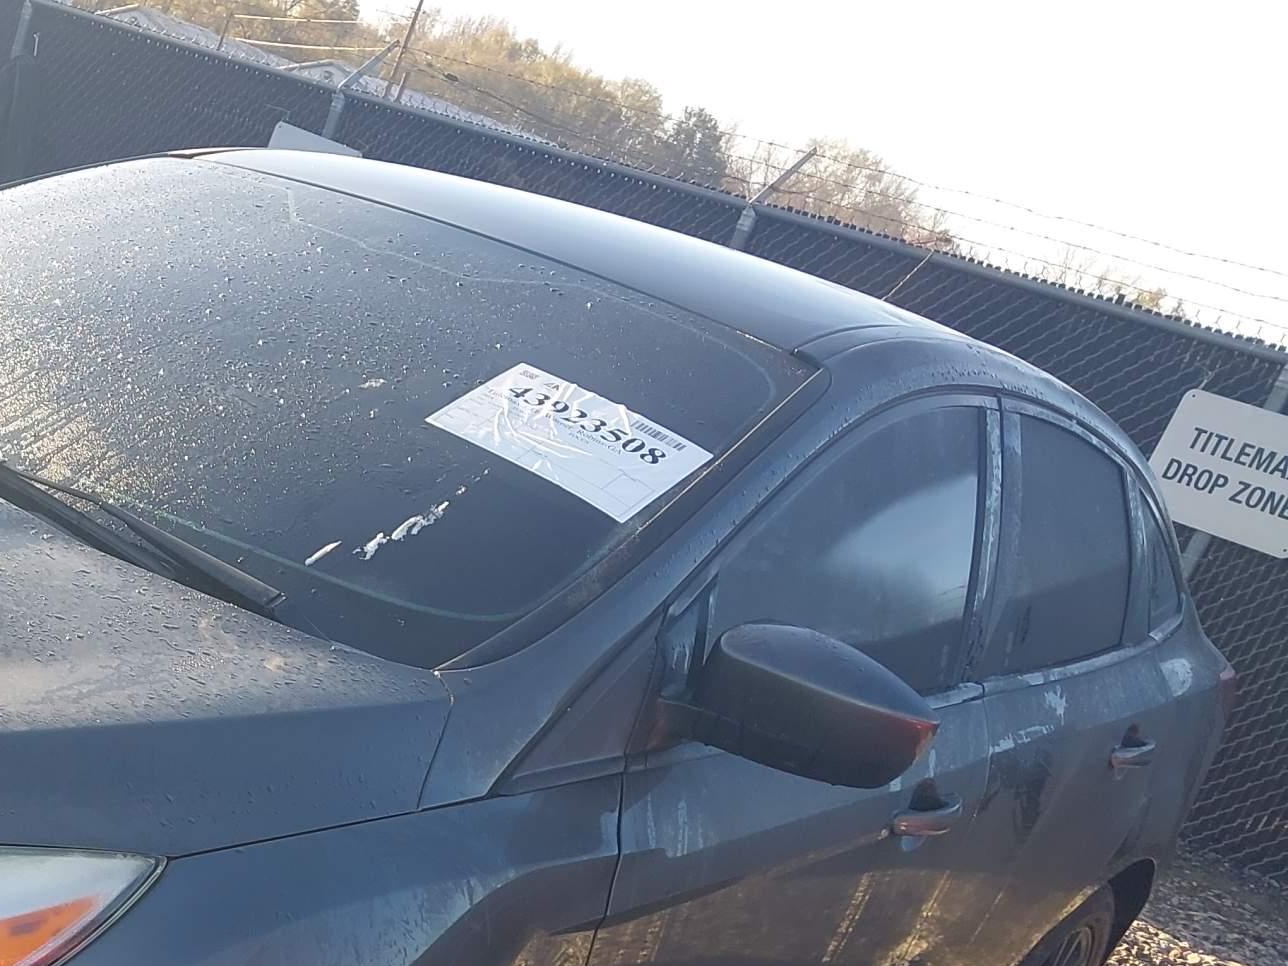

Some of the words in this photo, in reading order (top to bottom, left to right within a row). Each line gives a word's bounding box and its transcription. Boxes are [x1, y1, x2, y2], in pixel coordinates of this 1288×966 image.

[508, 386, 667, 465] 43923508
[1161, 458, 1230, 495] DROP
[1189, 426, 1288, 481] TITLEMA
